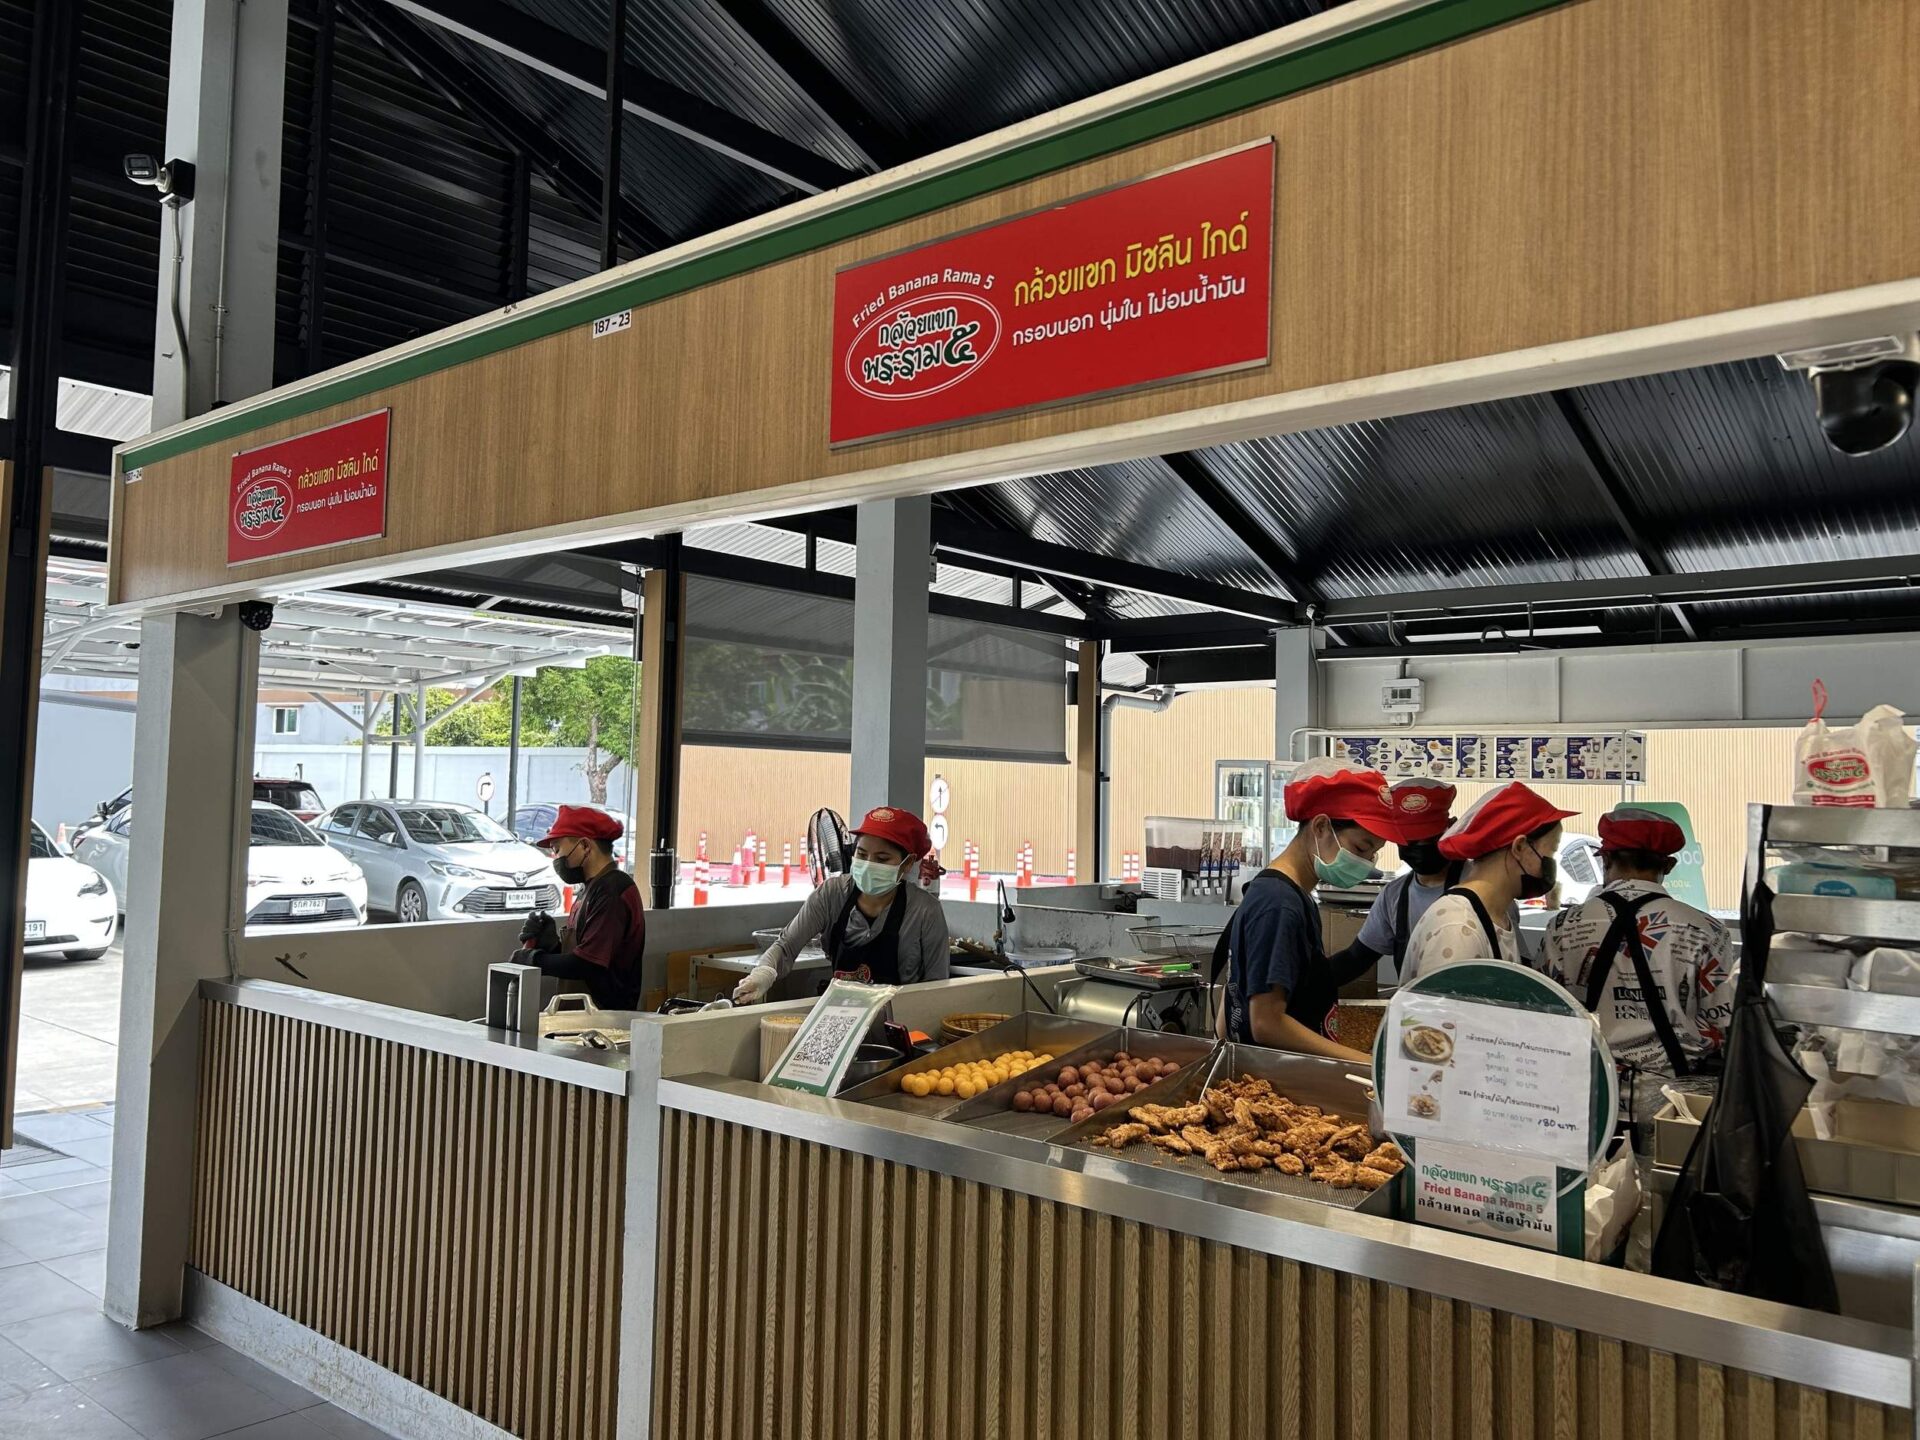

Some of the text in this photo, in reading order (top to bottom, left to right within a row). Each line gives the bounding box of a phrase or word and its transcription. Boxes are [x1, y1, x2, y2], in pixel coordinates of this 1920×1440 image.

[1014, 211, 1249, 307] กล้วยแขก มิชลิน ไกด์
[852, 269, 995, 328] Fried Banana Rama 5
[1012, 274, 1246, 346] กรอบนอก นุ่มใน ไม่อมน้ำมัน
[879, 308, 957, 347] กล้วยแขก
[237, 471, 251, 493] Fried
[252, 464, 272, 478] Banana
[272, 462, 287, 475] Rama
[298, 448, 379, 490] กล้วยแขก มิชลิน ไกด์
[297, 482, 377, 513] กรอบนอก นุ่มใน ไม่อมน้ำมัน
[1422, 1164, 1477, 1184] กล้วยแขก
[1418, 1197, 1552, 1233] กล้วยทอด สลัดน้ำมัน
[1424, 1182, 1543, 1214] Fried Banana Rama 5
